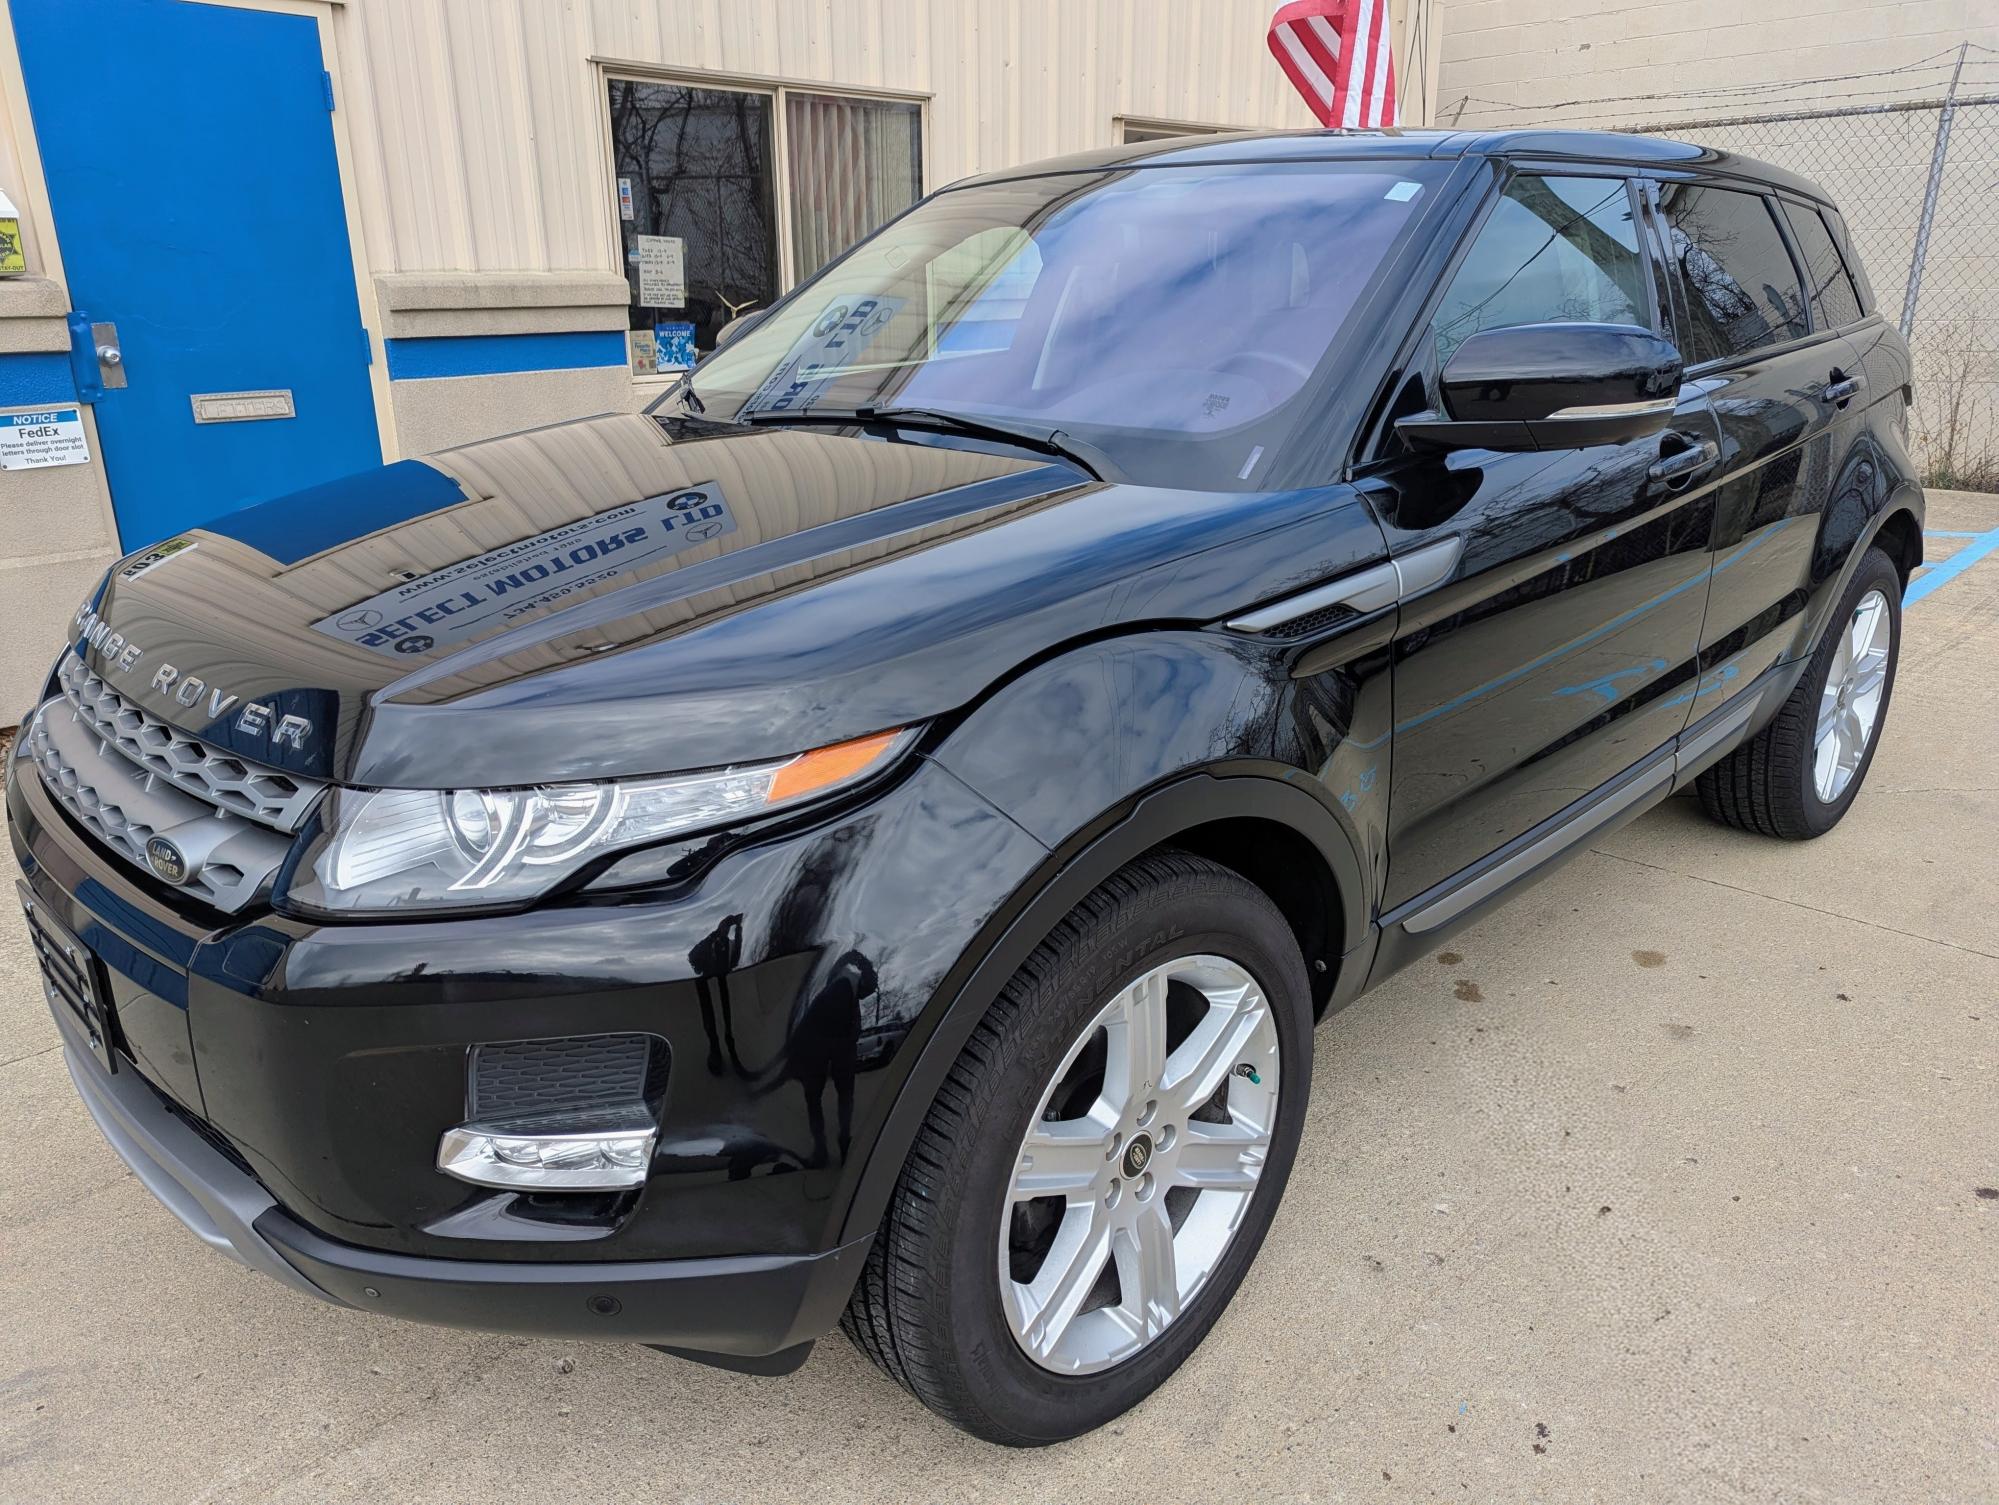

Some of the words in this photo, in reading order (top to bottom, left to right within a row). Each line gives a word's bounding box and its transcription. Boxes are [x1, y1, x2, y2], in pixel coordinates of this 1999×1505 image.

[13, 413, 58, 425] NOTICE
[18, 426, 60, 439] FedEx
[51, 436, 82, 445] overnight
[2, 449, 24, 457] letters
[26, 446, 52, 455] through
[25, 456, 49, 464] Thank
[76, 600, 144, 673] RANGE
[152, 663, 312, 749] ROVER
[152, 842, 171, 860] LAND
[154, 855, 178, 876] ROVER
